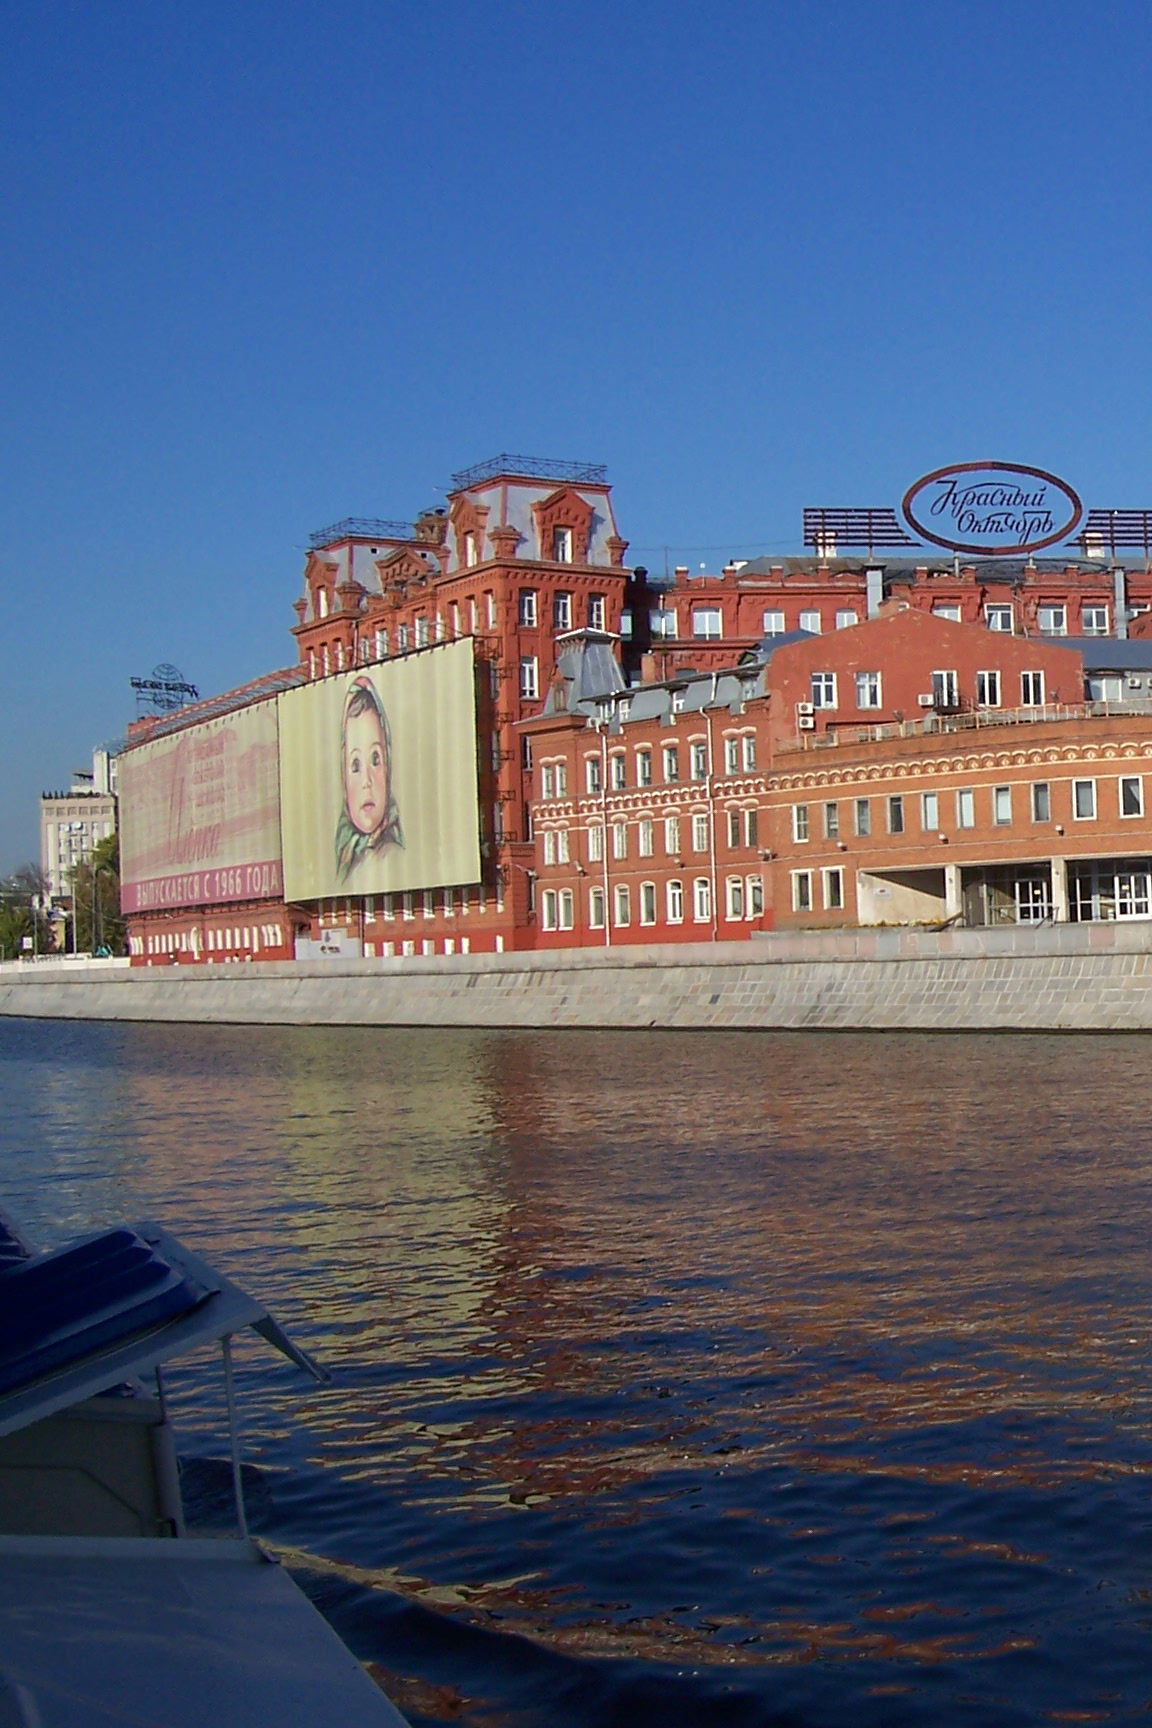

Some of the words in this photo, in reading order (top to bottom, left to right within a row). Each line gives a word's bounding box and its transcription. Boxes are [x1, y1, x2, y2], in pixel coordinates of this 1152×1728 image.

[930, 479, 1047, 518] Красный
[957, 510, 1054, 545] Октябрь
[136, 875, 200, 908] ВЫПУСКАЕТСЯ
[203, 873, 211, 898] С
[214, 868, 242, 897] 1966
[246, 863, 279, 897] ГОДА
